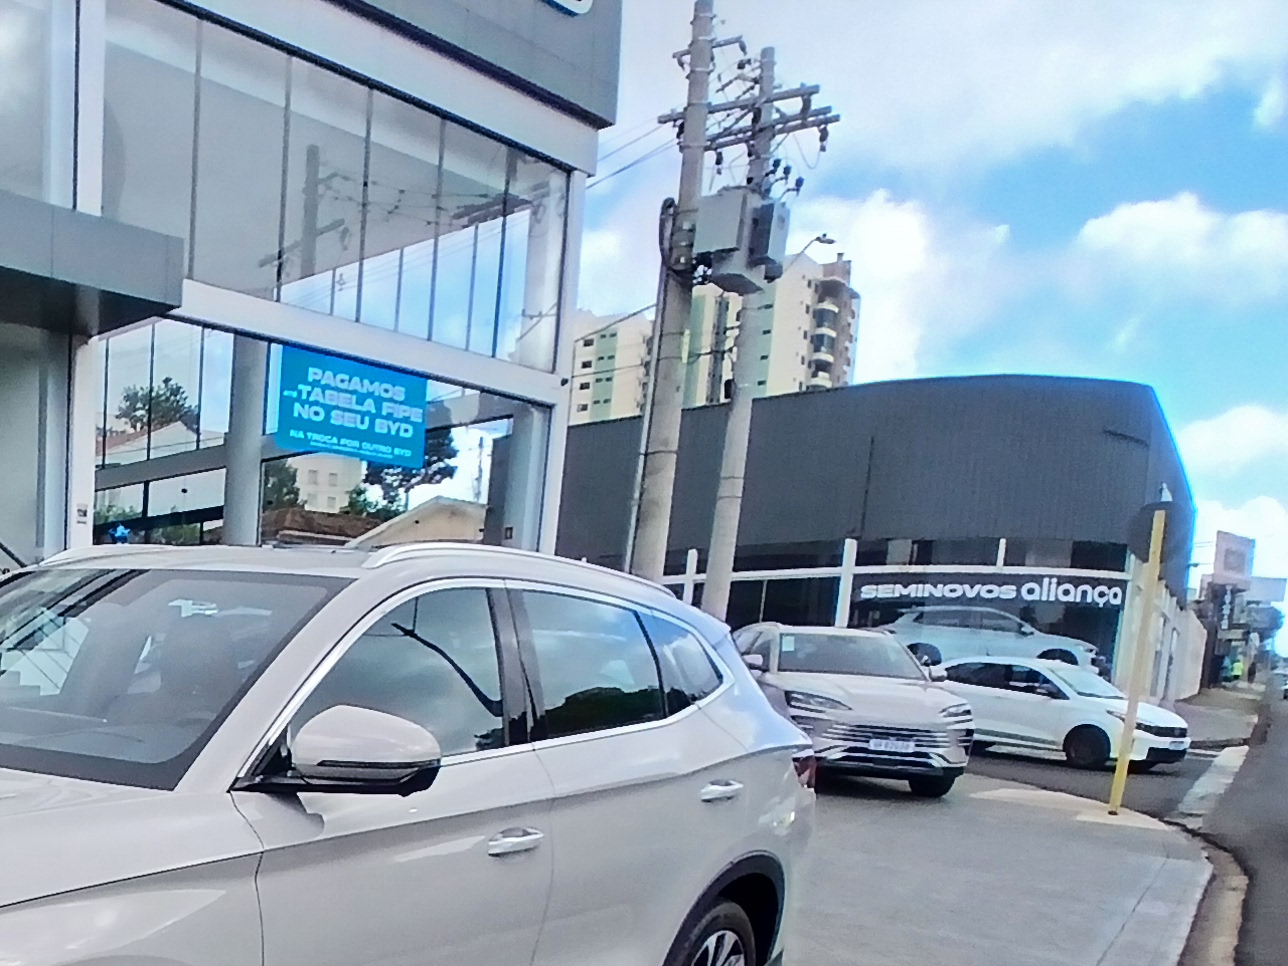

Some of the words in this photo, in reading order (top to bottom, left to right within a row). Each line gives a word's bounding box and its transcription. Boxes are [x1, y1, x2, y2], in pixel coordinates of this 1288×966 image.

[307, 366, 406, 402] PAGAMOS
[293, 402, 325, 422] NO
[330, 409, 369, 430] SEU
[374, 418, 414, 438] BYD
[297, 384, 376, 414] TABELA
[381, 400, 423, 423] FIPE
[860, 583, 1017, 600] SEMINOVOS
[1020, 577, 1122, 607] aliança
